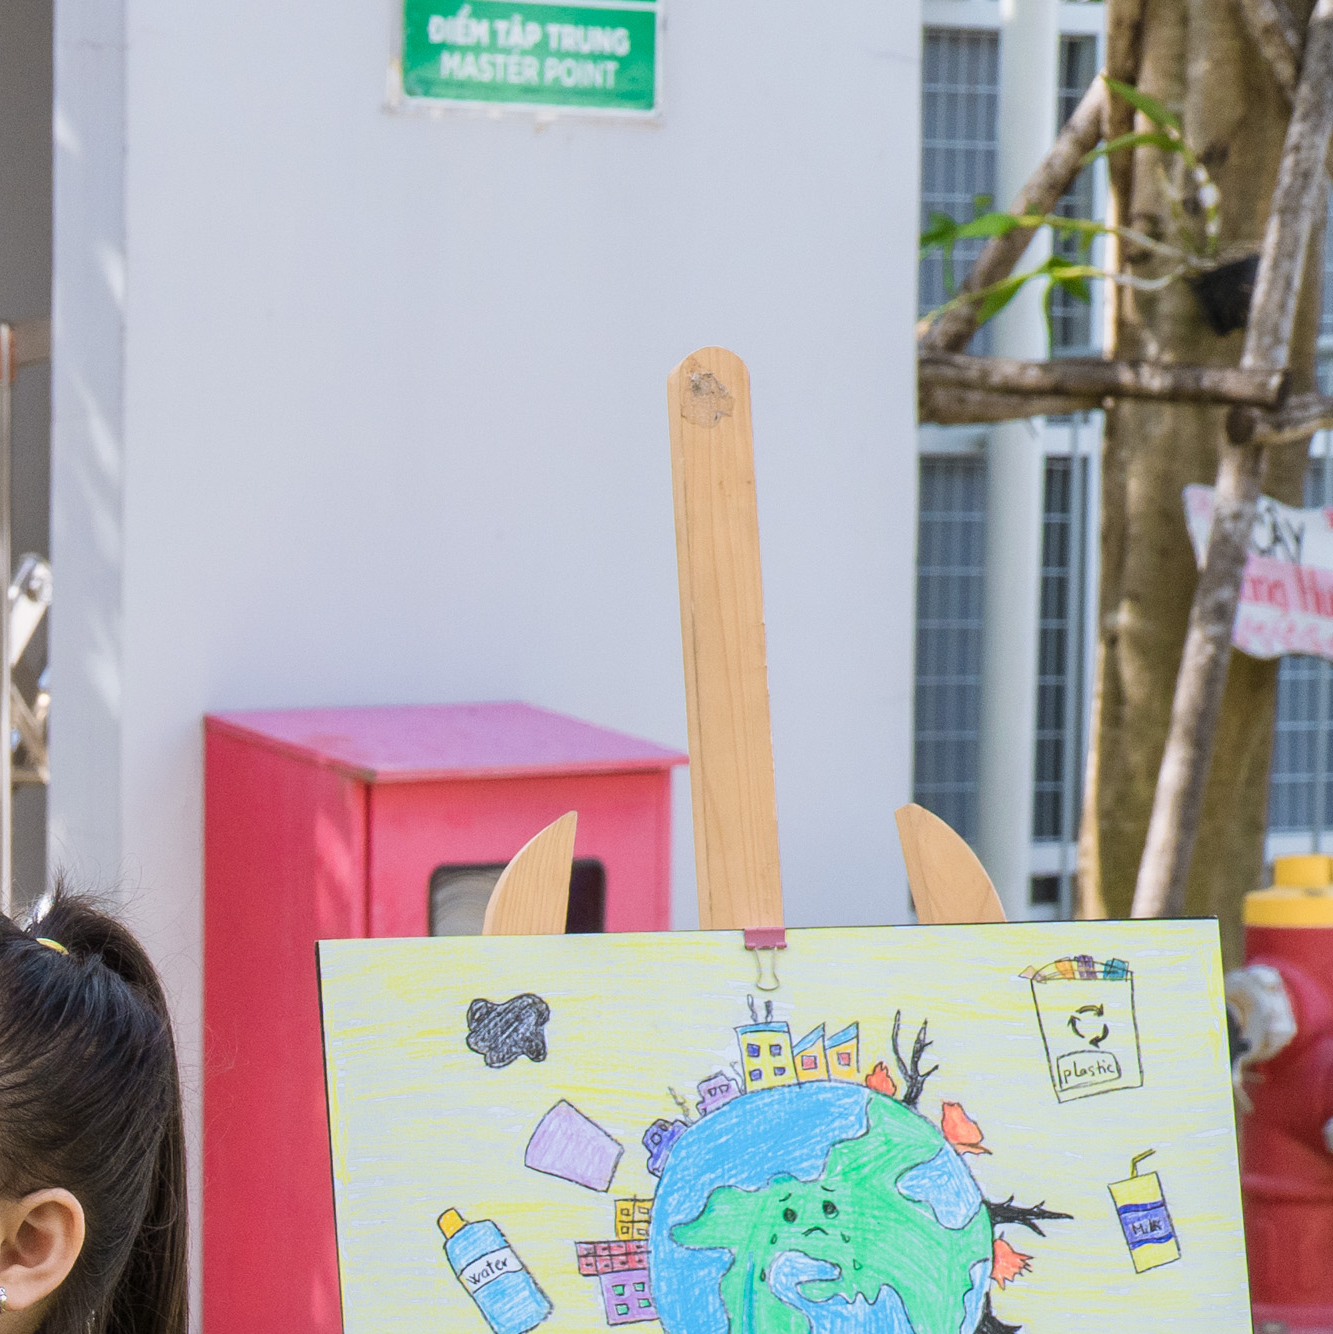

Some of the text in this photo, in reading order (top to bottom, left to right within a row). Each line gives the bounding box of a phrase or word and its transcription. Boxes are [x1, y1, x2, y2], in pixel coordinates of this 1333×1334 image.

[546, 23, 631, 57] TRUNG
[440, 50, 619, 89] MASTER POINT
[1063, 1060, 1116, 1084] plastic
[466, 1257, 509, 1285] water
